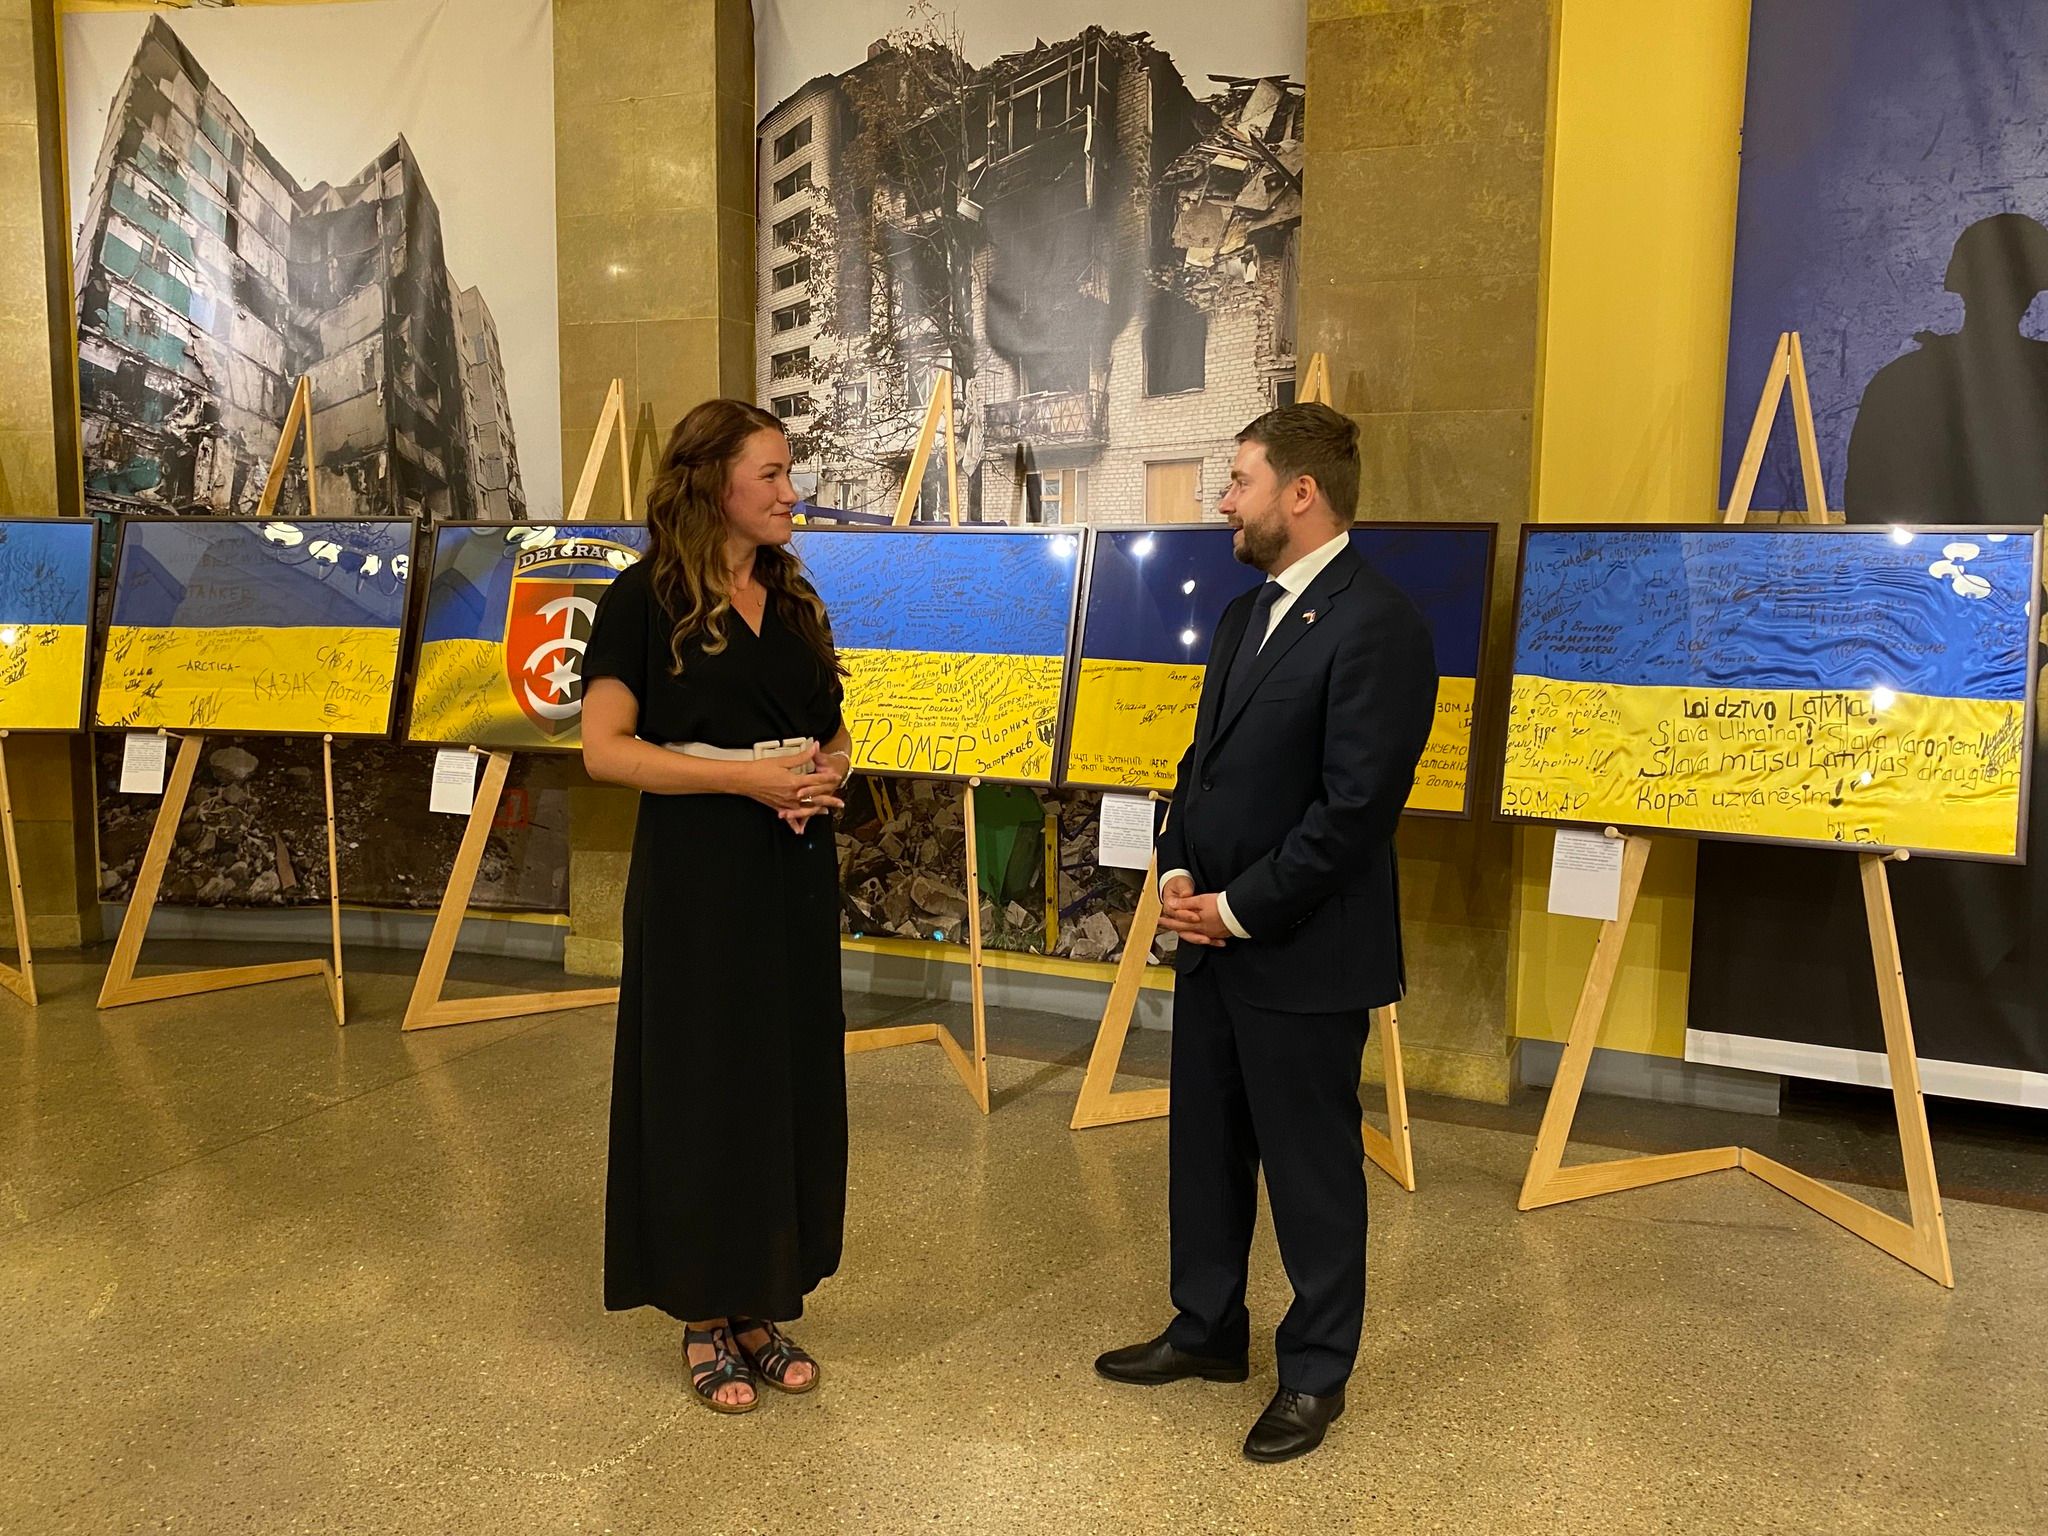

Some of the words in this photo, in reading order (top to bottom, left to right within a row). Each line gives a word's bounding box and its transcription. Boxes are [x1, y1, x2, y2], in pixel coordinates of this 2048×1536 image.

[520, 542, 556, 568] DEI
[982, 717, 1029, 745] Чорних
[1649, 719, 1708, 746] Slava
[853, 718, 888, 765] 72
[897, 733, 976, 774] ОМБР
[1638, 746, 1708, 778] Slava
